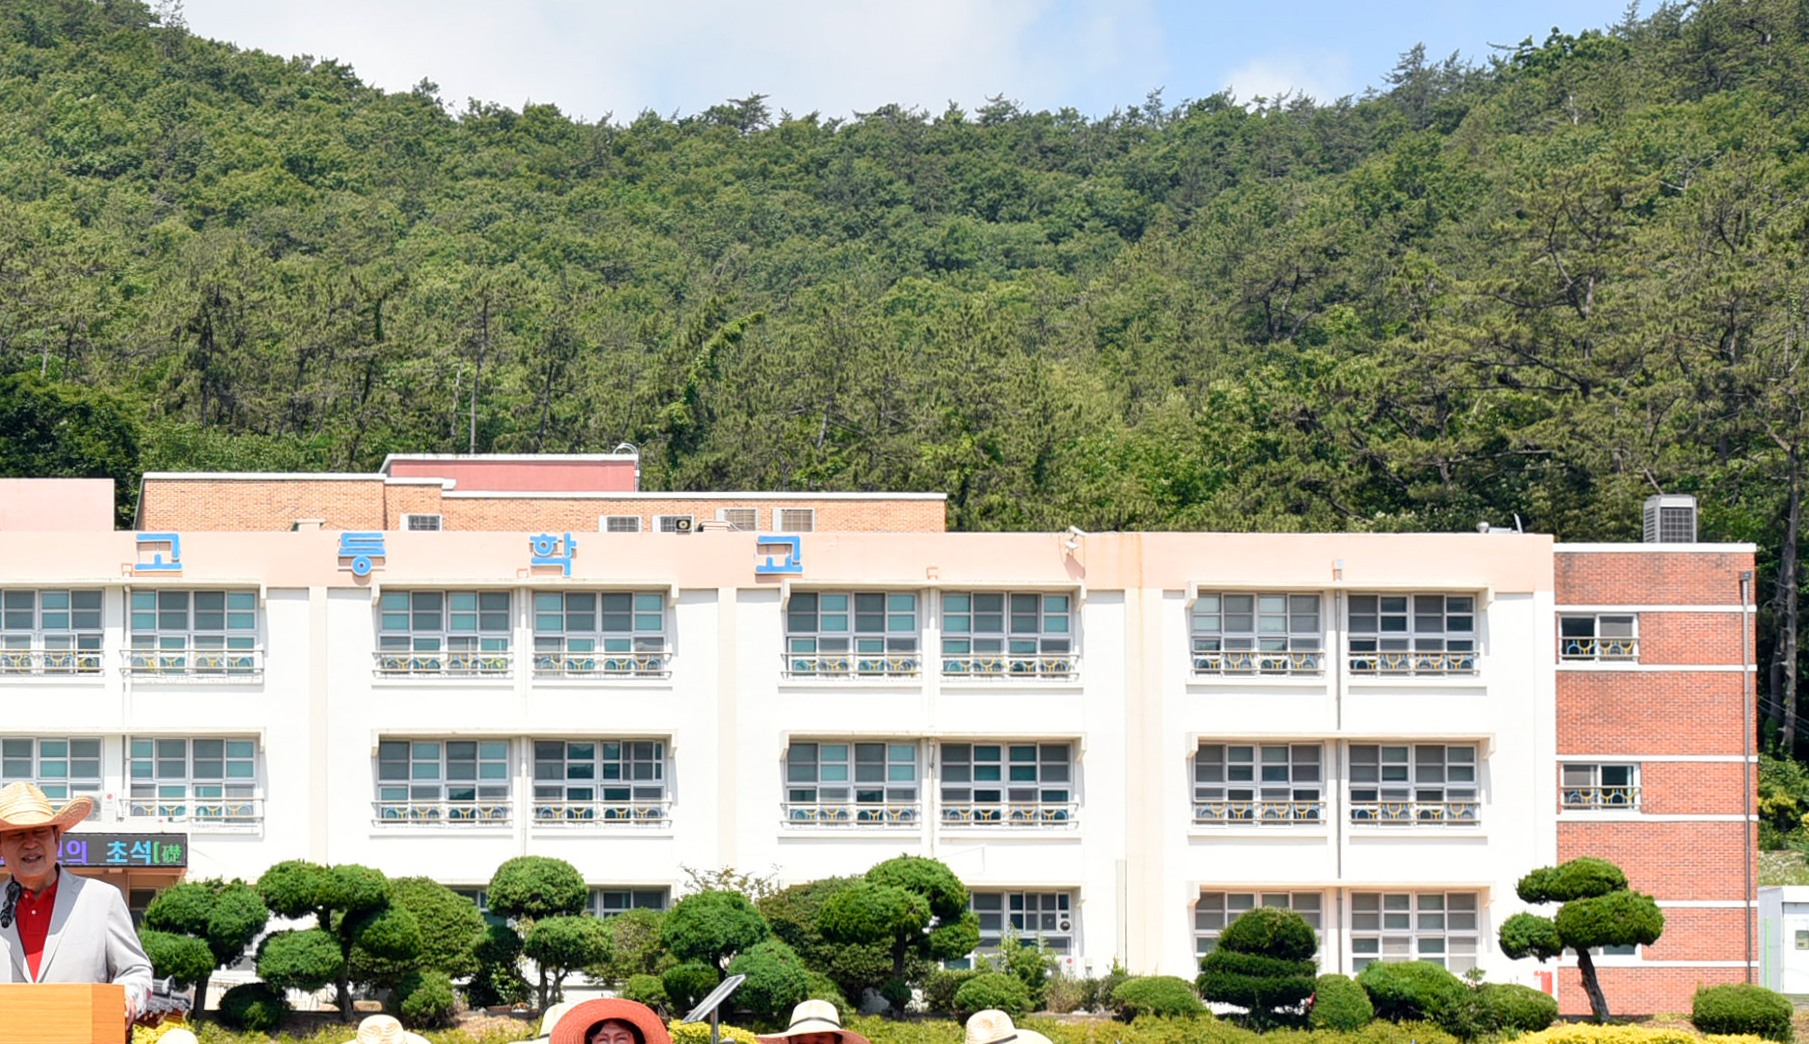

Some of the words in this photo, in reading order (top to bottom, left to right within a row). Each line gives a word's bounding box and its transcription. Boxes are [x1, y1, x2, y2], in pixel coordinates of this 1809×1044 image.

[135, 532, 183, 572] 고
[338, 532, 386, 577] 등
[530, 532, 577, 577] 학
[755, 534, 804, 575] 교
